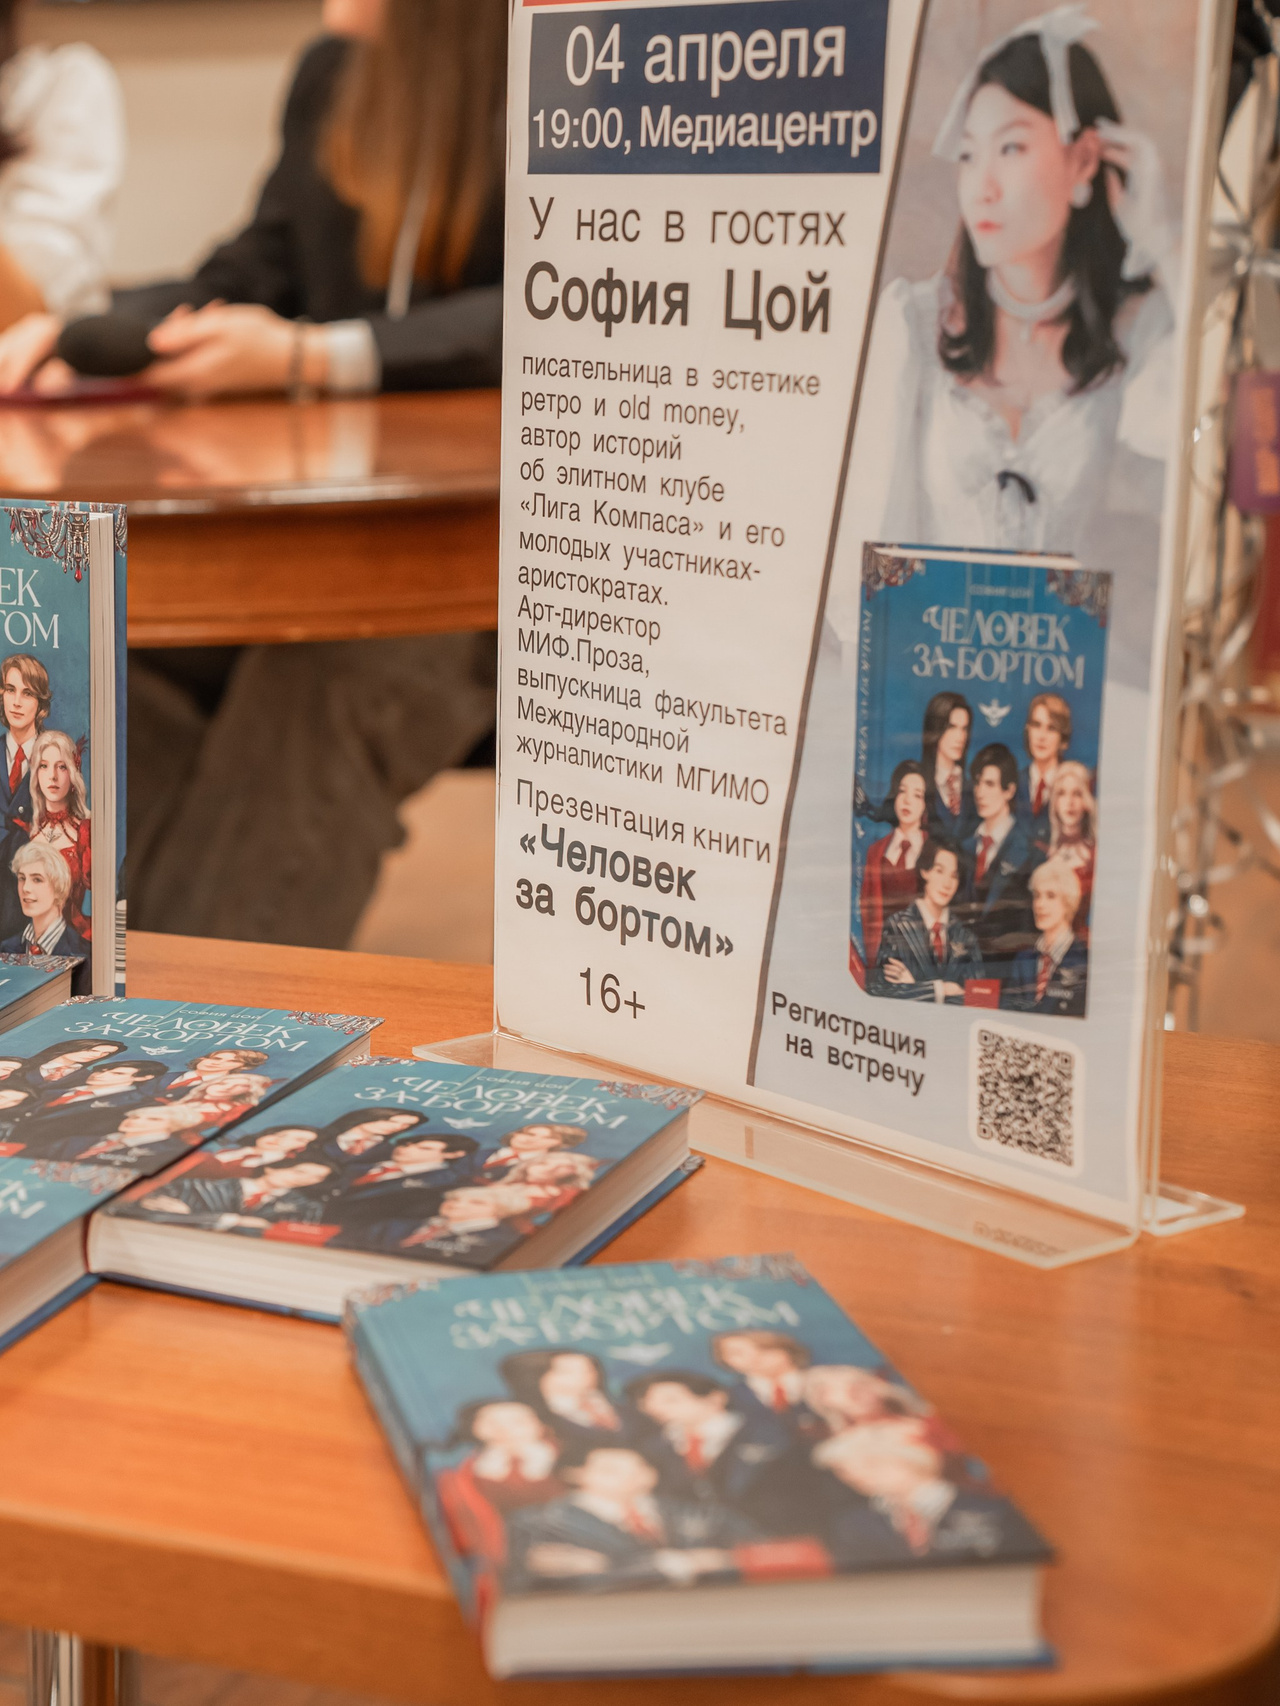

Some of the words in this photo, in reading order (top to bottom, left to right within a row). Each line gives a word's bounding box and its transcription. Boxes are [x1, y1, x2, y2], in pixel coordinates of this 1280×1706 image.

[566, 23, 624, 86] 04
[644, 26, 846, 98] апреля
[533, 108, 631, 155] 19:00,
[640, 105, 878, 157] Медиацентр
[529, 197, 555, 240] У
[576, 208, 641, 242] нас
[666, 211, 685, 242] в
[711, 211, 846, 247] гостях
[525, 261, 689, 337] София
[725, 269, 831, 340] Цой
[522, 356, 671, 388] писательница
[687, 368, 698, 386] в
[713, 369, 820, 395] эстетике
[521, 390, 581, 418] ретро
[595, 398, 605, 416] и
[620, 394, 650, 420] old
[664, 402, 745, 434] money,
[521, 426, 581, 455] автор
[593, 434, 682, 463] историй
[521, 458, 544, 481] об
[557, 465, 646, 493] элитном
[660, 475, 725, 505] клубе
[520, 492, 580, 522] «Лига
[593, 500, 704, 535] Компаса»
[720, 522, 731, 539] и
[746, 524, 785, 546] его
[520, 531, 610, 562] молодых
[623, 545, 761, 581] участниках-
[518, 566, 668, 606] аристократах.
[518, 595, 660, 645] Арт-директор
[922, 605, 1070, 652] ЧЕЛОВЕК
[518, 628, 649, 677] МИФ.Проза,
[912, 644, 954, 678] ЗА
[957, 646, 1085, 689] БОРТОМ
[517, 696, 689, 753] Международной
[518, 668, 641, 709] выпускница
[655, 690, 787, 735] факультета
[517, 735, 663, 784] журналистики
[677, 763, 769, 805] МГИМО
[517, 779, 684, 844] Презентация
[693, 826, 770, 864] книги
[520, 823, 696, 901] «Человек
[516, 878, 555, 916] за
[576, 886, 734, 957] бортом»
[580, 967, 645, 1019] 16+
[102, 1012, 303, 1039] ЧЕЛОВЕК
[772, 991, 926, 1058] Регистрация
[786, 1033, 813, 1058] на
[828, 1045, 924, 1097] встречу
[393, 1076, 617, 1113] ЧЕЛОВЕК
